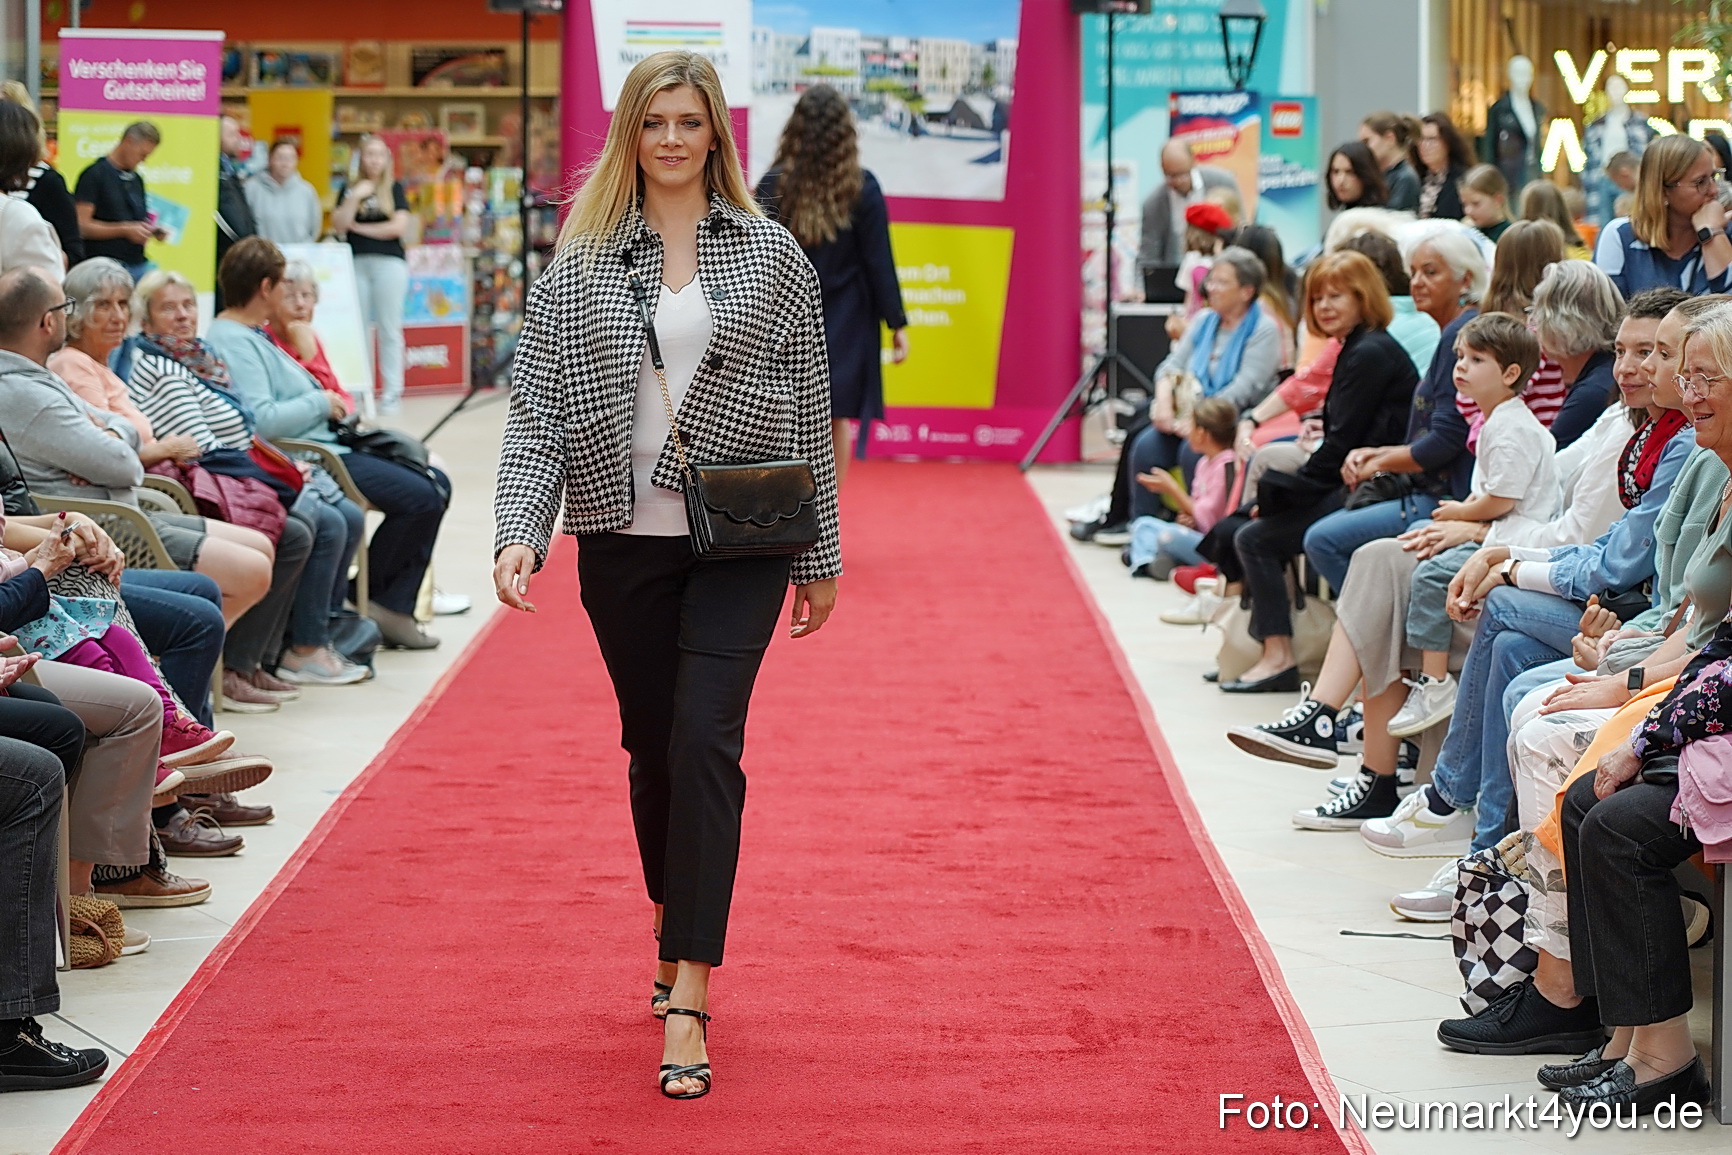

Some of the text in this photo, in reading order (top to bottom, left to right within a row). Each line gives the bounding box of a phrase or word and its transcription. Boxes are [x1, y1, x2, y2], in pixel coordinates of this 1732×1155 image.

[68, 58, 206, 80] Verschenken Sie
[1554, 49, 1732, 104] VER
[103, 79, 206, 101] Gutscheine!
[1272, 110, 1302, 128] LEGO
